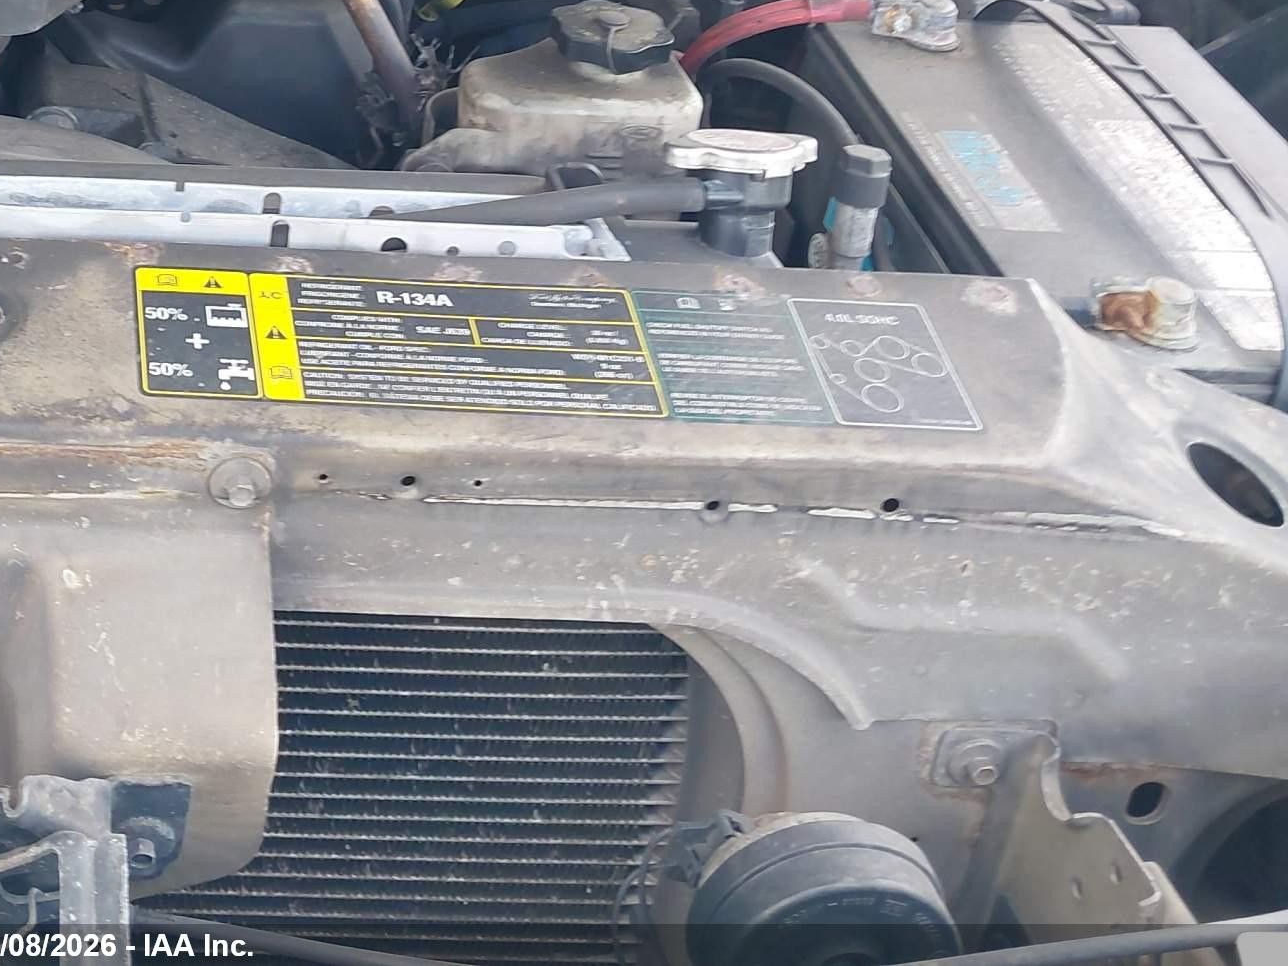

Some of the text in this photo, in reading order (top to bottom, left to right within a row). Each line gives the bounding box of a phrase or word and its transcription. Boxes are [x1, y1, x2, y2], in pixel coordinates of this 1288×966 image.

[375, 290, 455, 308] R-134A
[144, 306, 189, 322] 50%
[148, 362, 194, 378] 50%
